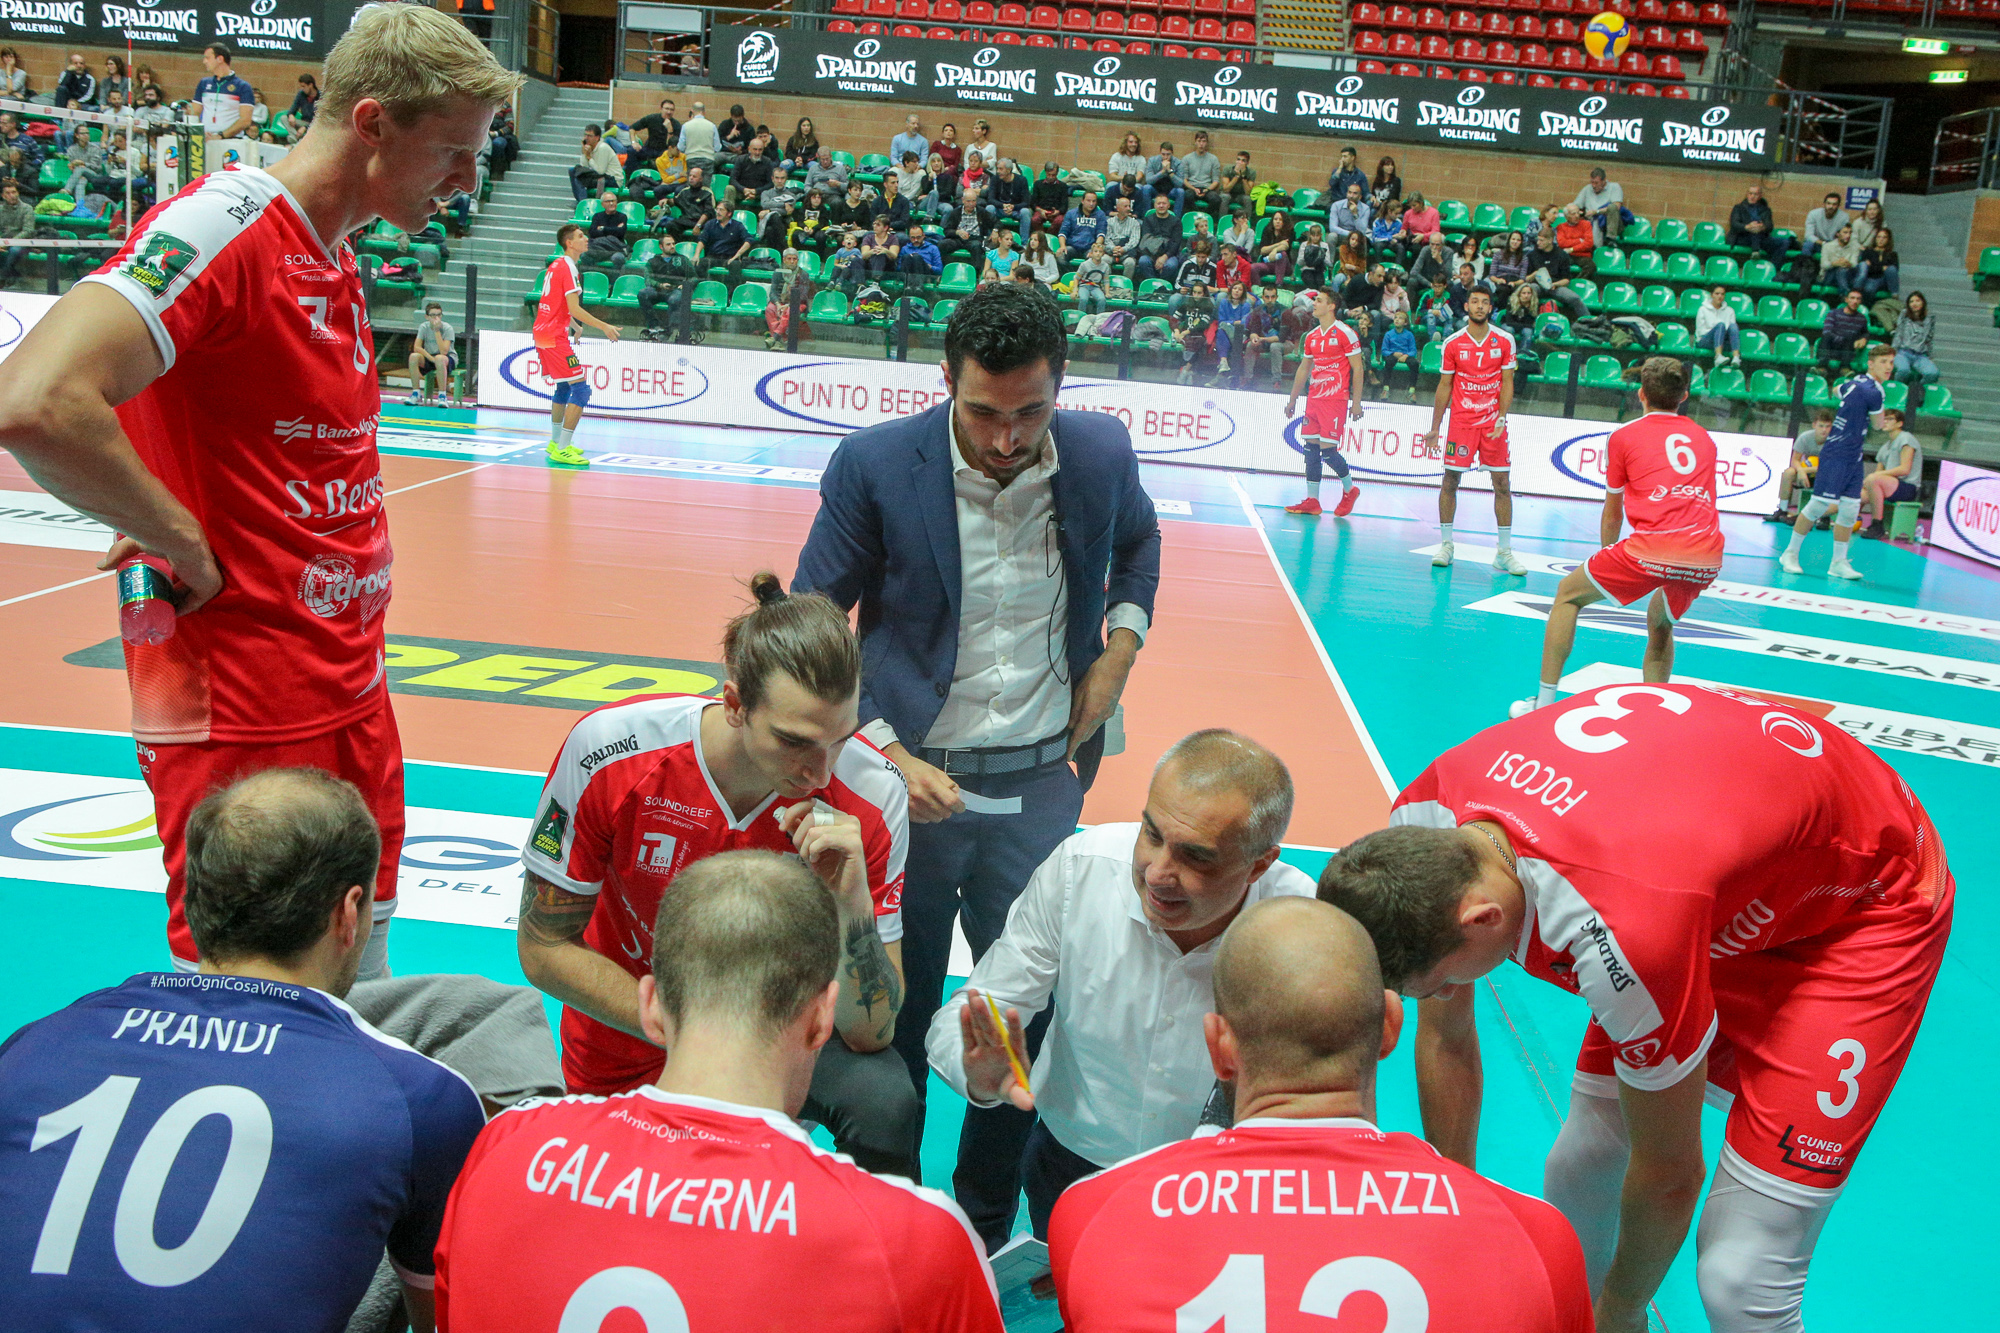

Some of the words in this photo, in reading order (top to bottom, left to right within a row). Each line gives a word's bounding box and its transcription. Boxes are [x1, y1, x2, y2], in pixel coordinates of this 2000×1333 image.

[0, 0, 84, 26] PALDING
[9, 21, 66, 35] VOLLEYBALL
[101, 3, 198, 34] SPALDING
[215, 11, 312, 43] SPALDING
[123, 29, 179, 43] VOLLEYBALL
[236, 37, 292, 51] VOLLEYBALL
[815, 53, 916, 85] SPALDING
[934, 62, 1035, 94] SPALDING
[837, 80, 895, 94] VOLLEYBALL
[956, 89, 1014, 103] VOLLEYBALL
[1054, 71, 1155, 104] SPALDING
[1174, 80, 1276, 114] SPALDING
[1076, 98, 1134, 112] VOLLEYBALL
[1197, 107, 1254, 122] VOLLEYBALL
[1295, 90, 1398, 124] SPALDING
[1416, 100, 1520, 135] SPALDING
[1317, 117, 1376, 132] VOLLEYBALL
[1439, 127, 1497, 142] VOLLEYBALL
[1538, 110, 1642, 145] SPALDING
[1660, 121, 1765, 155] SPALDING
[191, 135, 204, 179] ANCA
[1560, 137, 1619, 153] VOLLEYBALL
[1682, 148, 1741, 163] VOLLEYBALL
[1851, 188, 1872, 197] BAR
[1320, 340, 1325, 352] 1
[1475, 352, 1484, 367] 7
[526, 360, 609, 390] PTO
[621, 367, 685, 397] BERE
[782, 380, 869, 411] PUNTO
[1144, 410, 1211, 440] BERE
[1333, 416, 1339, 429] 1
[1337, 427, 1400, 456] UNTO
[1665, 433, 1697, 475] 6
[1671, 484, 1712, 502] EGEA
[1956, 496, 2000, 534] PUNTO
[1637, 560, 1664, 572] Agenzia
[1665, 567, 1695, 577] Generale
[1766, 644, 2000, 688] RIPAR
[1554, 686, 1691, 753] 3
[580, 734, 640, 776] SPALDING
[1485, 750, 1588, 817] FOCOSI
[644, 796, 713, 818] SOUNDREEF
[535, 840, 557, 855] BANCA
[635, 860, 670, 876] SQUARE
[1580, 914, 1636, 992] SPALDING
[150, 975, 300, 1001] #AmorOgniCosaVince
[112, 1007, 282, 1055] PRANDI
[1816, 1038, 1867, 1119] 3
[1796, 1134, 1843, 1153] CUNEO
[1799, 1149, 1846, 1167] VOLLEY
[30, 1074, 273, 1287] 10
[526, 1137, 797, 1236] GALAVERNA
[1152, 1170, 1460, 1217] CORTELLAZZI
